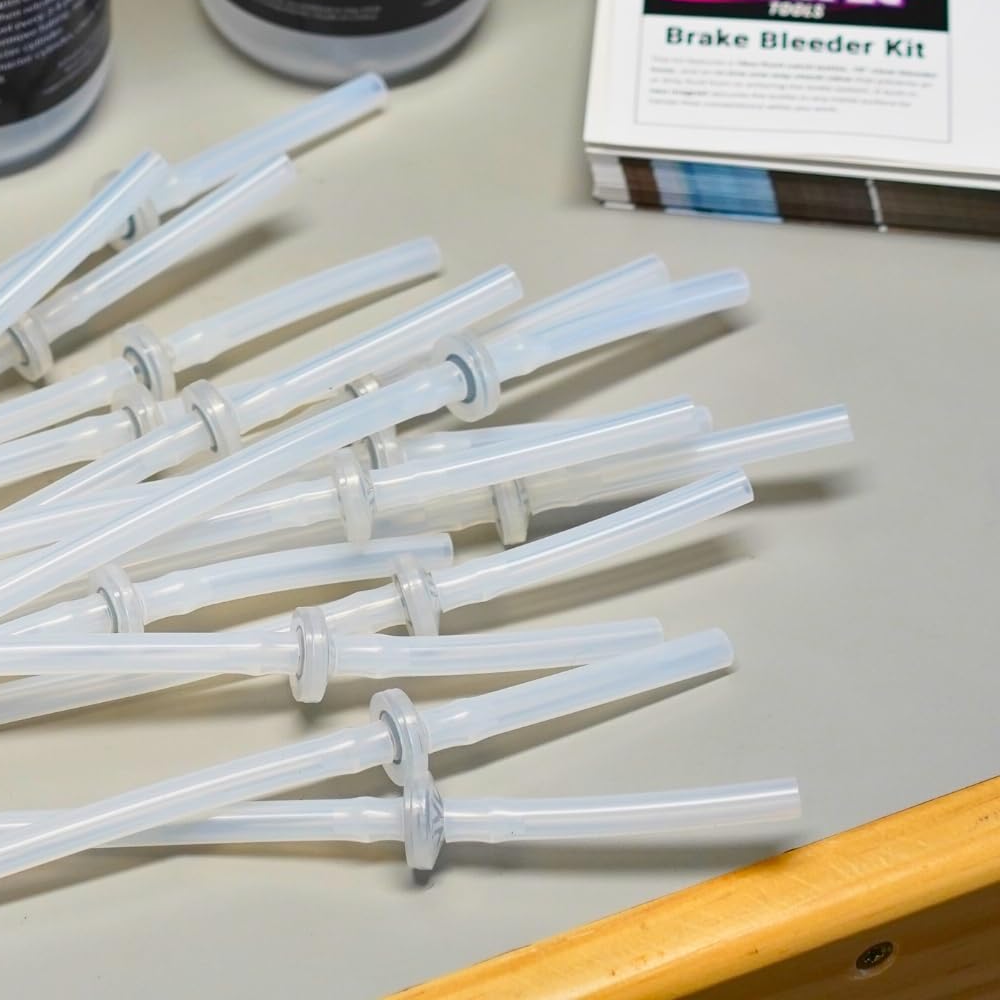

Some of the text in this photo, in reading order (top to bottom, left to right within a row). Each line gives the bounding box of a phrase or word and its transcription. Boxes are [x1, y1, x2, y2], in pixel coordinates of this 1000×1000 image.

[768, 0, 825, 19] TOOLS
[666, 25, 925, 59] Brake Bleeder Kit
